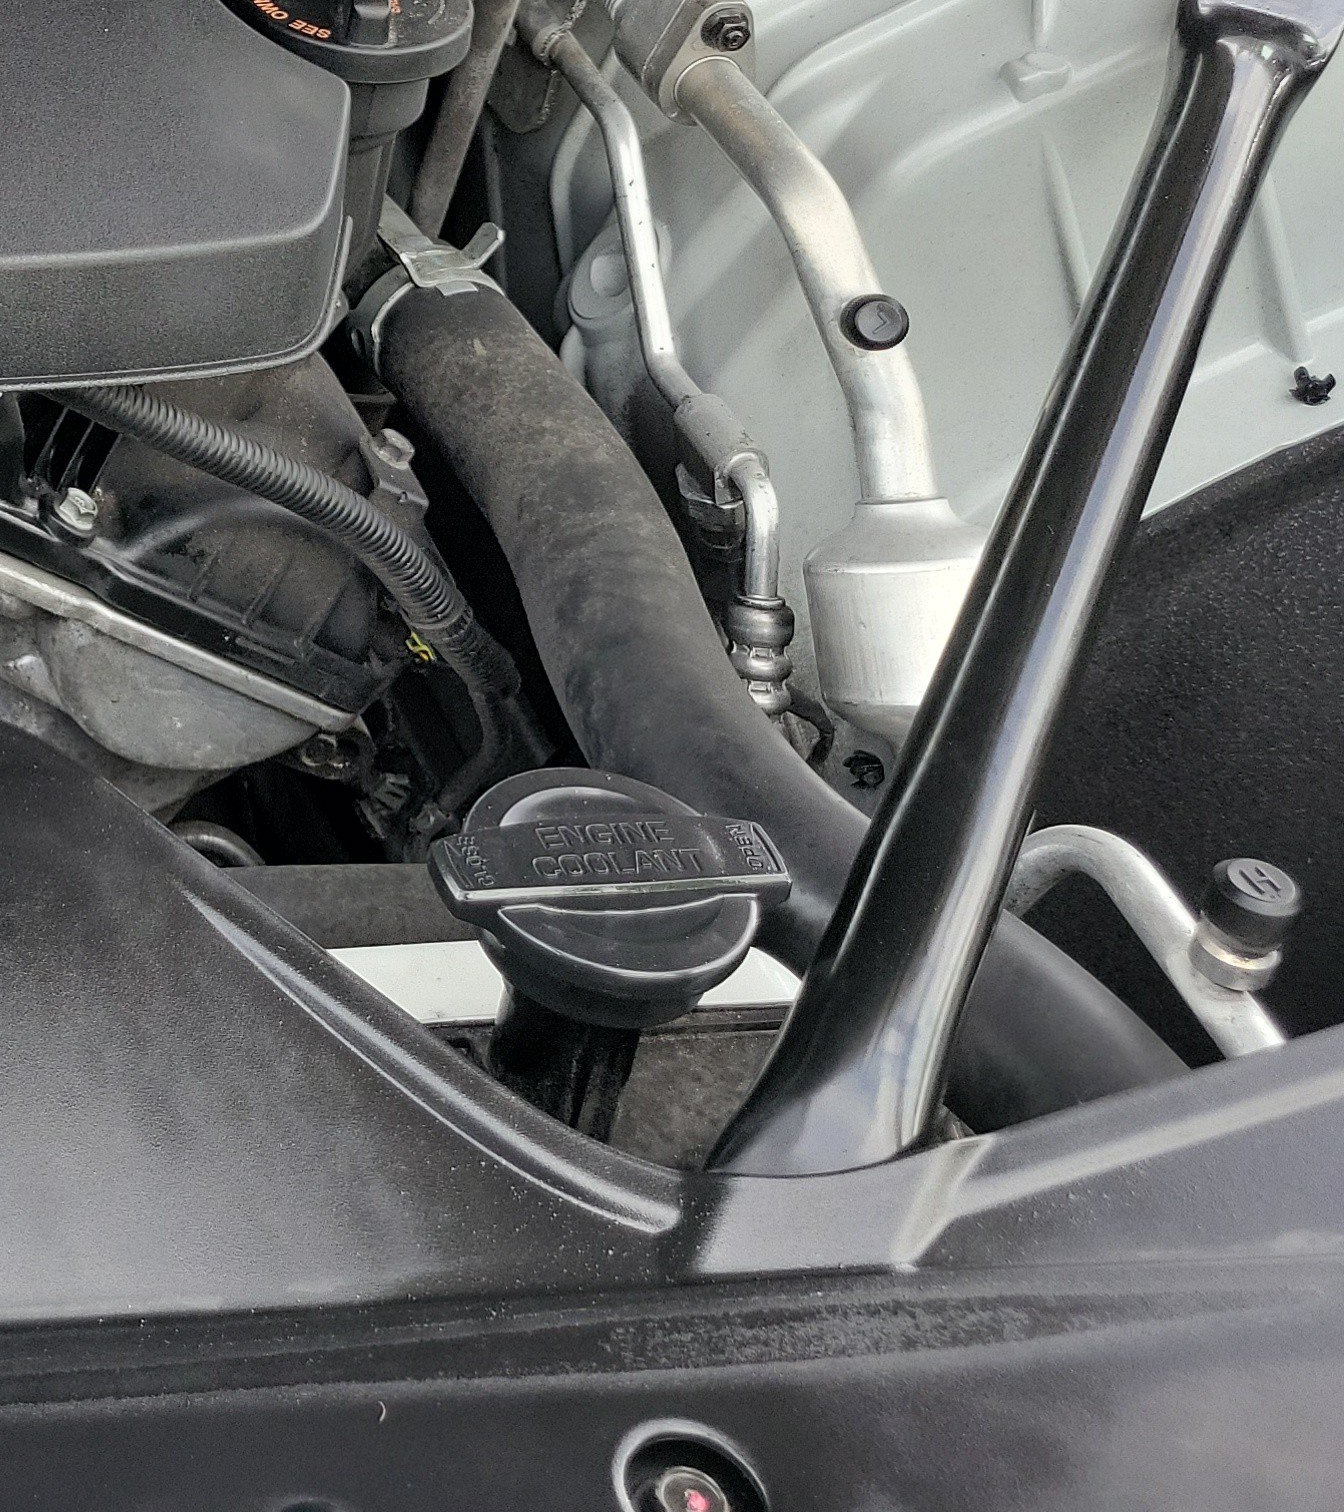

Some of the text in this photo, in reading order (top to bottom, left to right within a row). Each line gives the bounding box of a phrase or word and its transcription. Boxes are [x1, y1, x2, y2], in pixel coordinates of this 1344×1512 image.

[289, 19, 332, 40] SEE
[534, 820, 675, 850] ENGINE
[725, 823, 766, 873] OPEN
[531, 847, 704, 880] COOLANT
[1238, 864, 1281, 895] H
